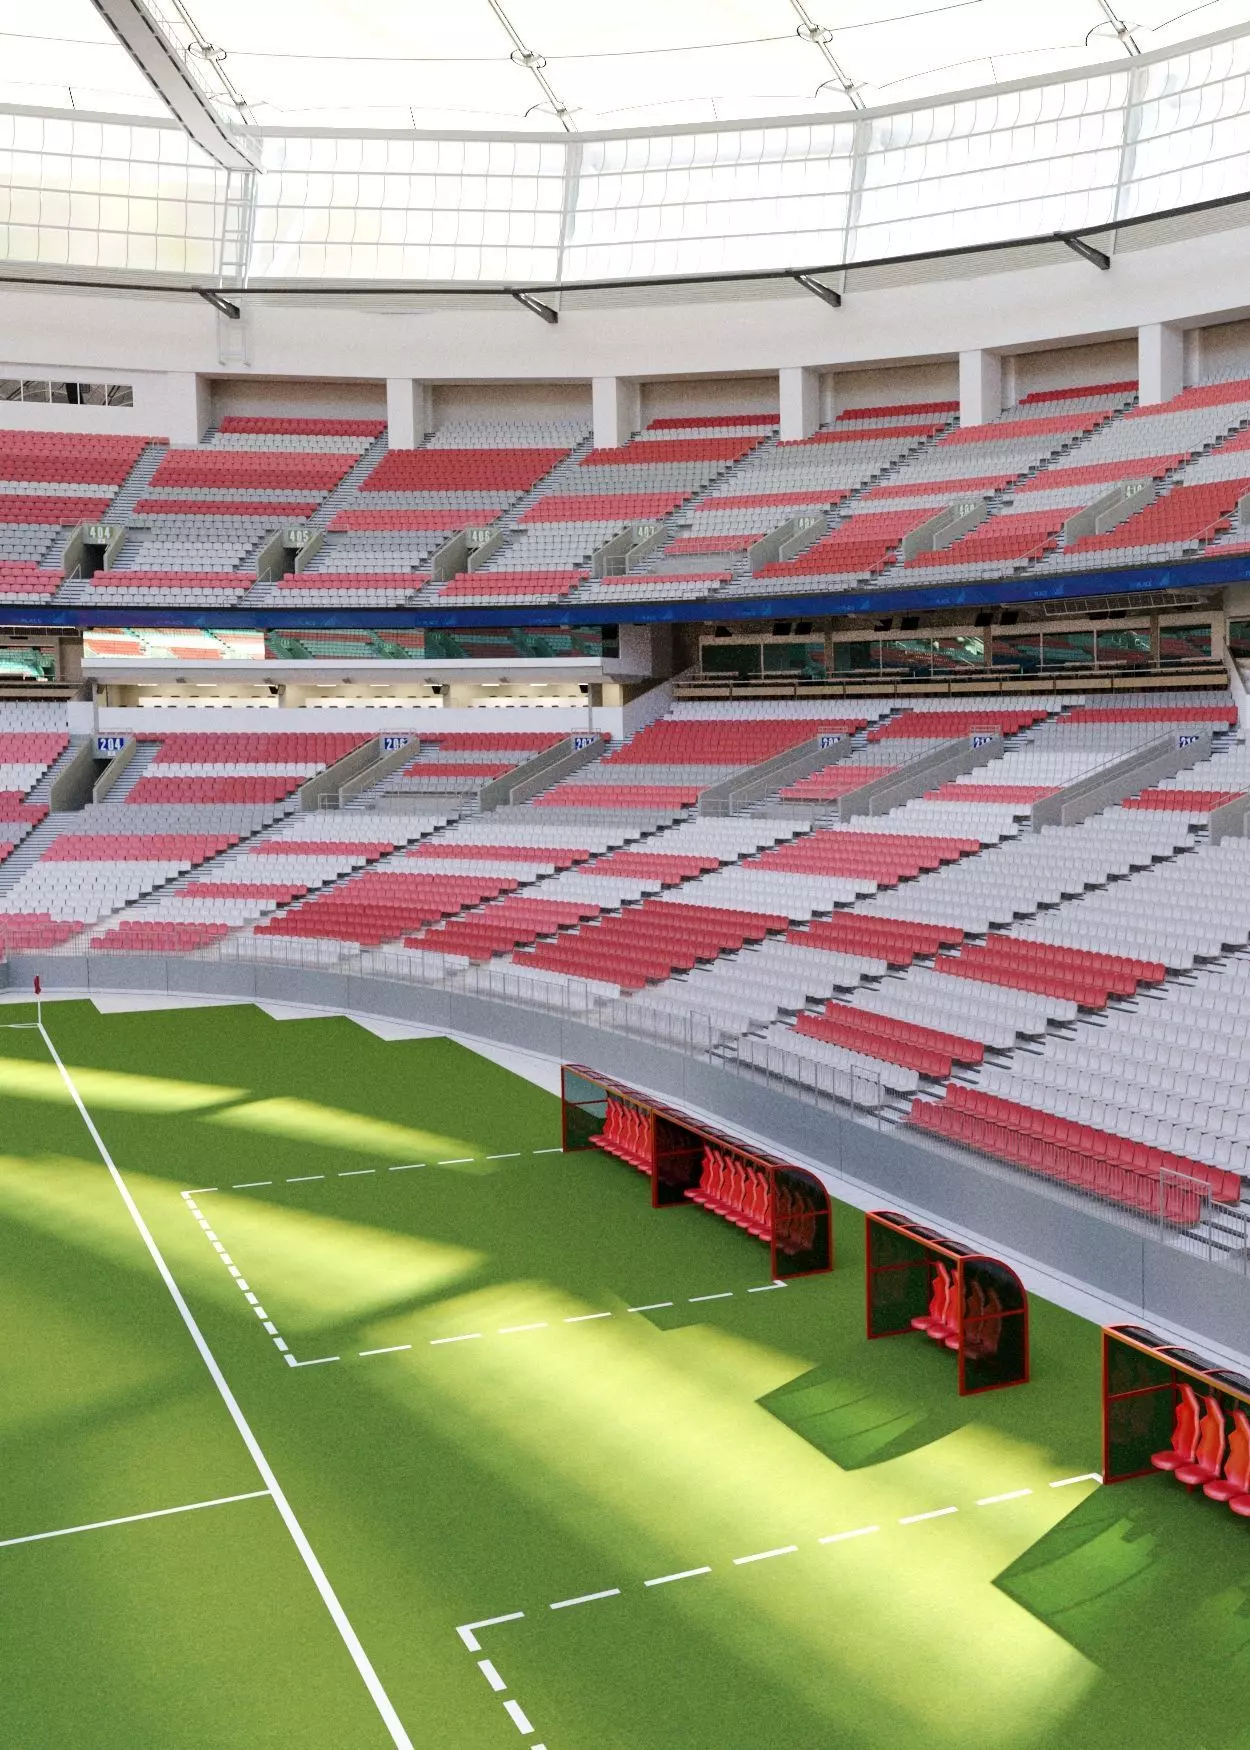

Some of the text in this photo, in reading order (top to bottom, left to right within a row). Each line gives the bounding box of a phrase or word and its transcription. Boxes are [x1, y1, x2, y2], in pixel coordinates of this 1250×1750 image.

[89, 526, 111, 539] 404
[289, 530, 309, 541] 405
[100, 738, 120, 751] 204
